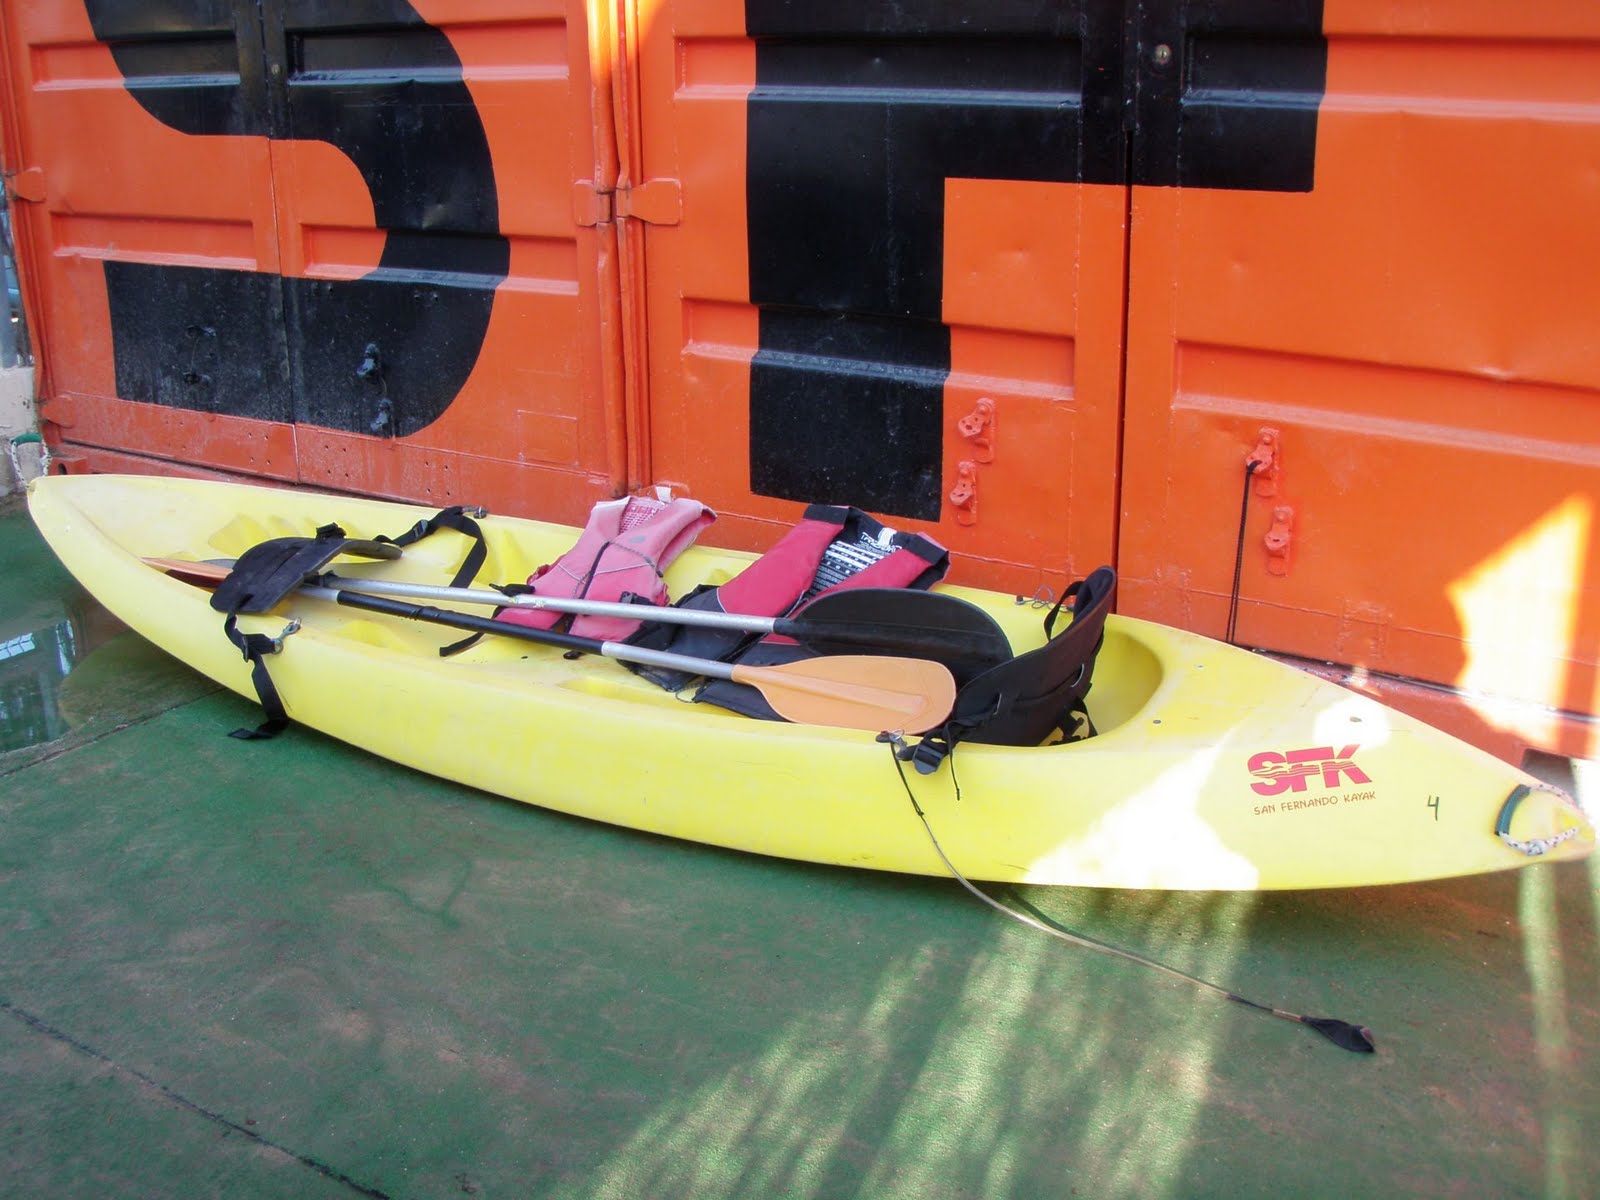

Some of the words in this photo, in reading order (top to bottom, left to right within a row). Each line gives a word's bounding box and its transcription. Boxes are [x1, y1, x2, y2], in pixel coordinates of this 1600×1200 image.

[1247, 743, 1373, 796] SFK
[1253, 804, 1276, 816] SAN
[1280, 795, 1339, 812] FERNANDO
[1343, 790, 1377, 804] KAYAK
[1426, 794, 1440, 822] 4
